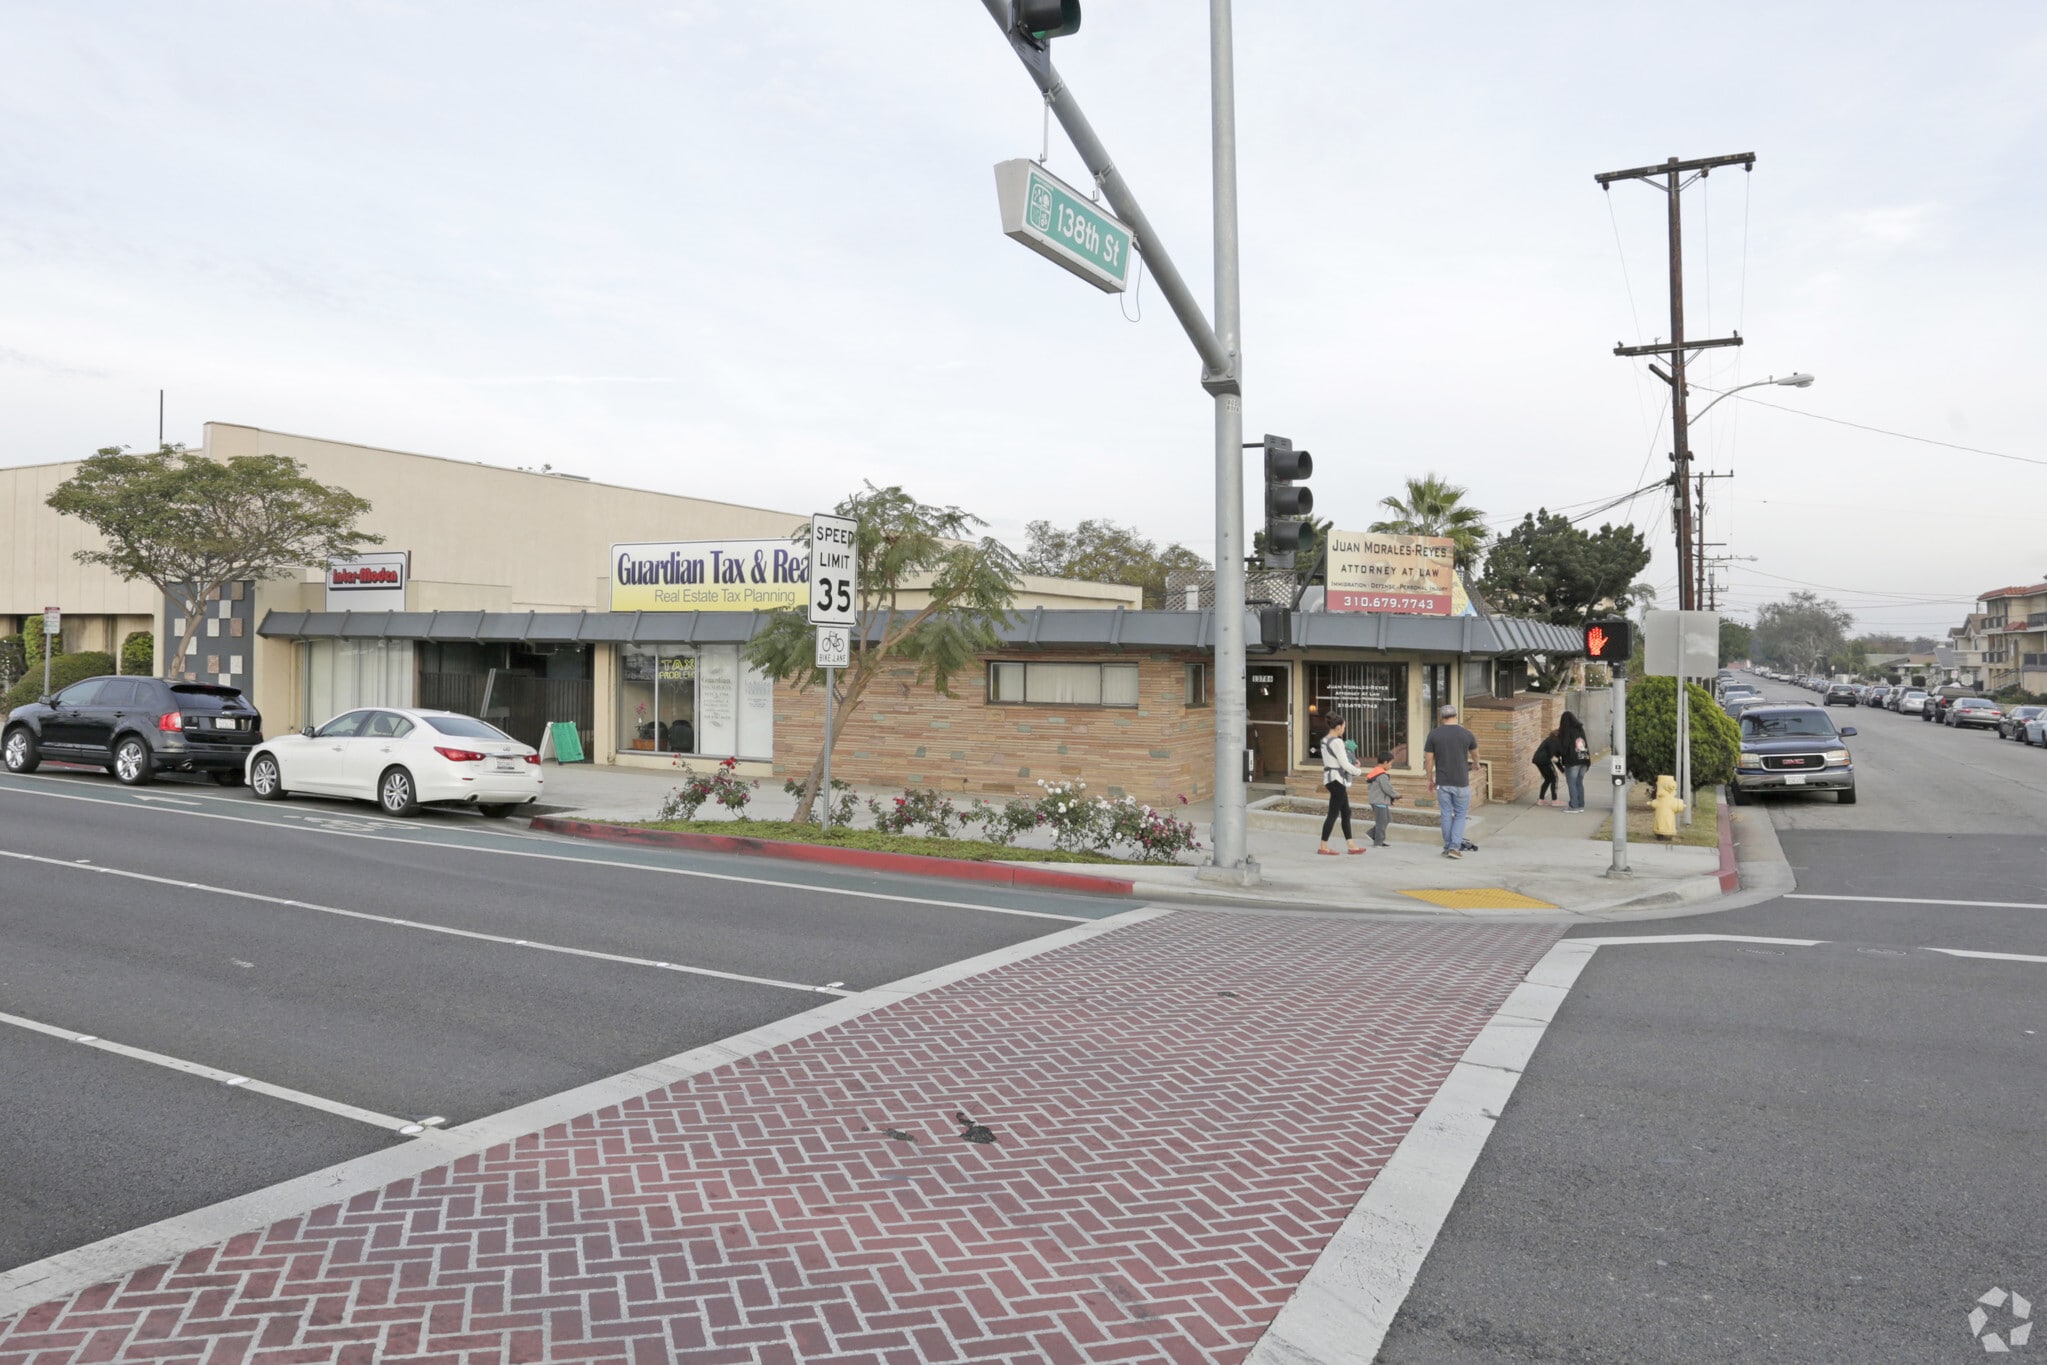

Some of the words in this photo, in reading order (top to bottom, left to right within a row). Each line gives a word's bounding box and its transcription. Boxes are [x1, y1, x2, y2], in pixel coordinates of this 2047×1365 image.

[1057, 203, 1100, 255] 138th
[1103, 234, 1120, 267] St
[816, 526, 854, 546] SPEED
[1332, 539, 1360, 553] JUAN
[617, 551, 705, 586] Guardian
[710, 550, 746, 585] Tax
[750, 549, 768, 585] &
[820, 552, 850, 569] LIMIT
[1340, 564, 1396, 575] ATTORNEY
[1401, 567, 1414, 577] AT
[1419, 568, 1439, 577] LAW
[1370, 582, 1395, 590] DEFENSE
[654, 589, 680, 603] Real
[683, 589, 719, 603] Estate
[721, 589, 741, 603] Tax
[744, 589, 796, 606] Planning
[816, 577, 851, 613] 35
[1343, 596, 1434, 610] 310.679.7743
[660, 659, 696, 671] TAX
[819, 654, 831, 662] BIKE
[832, 654, 846, 663] LANE
